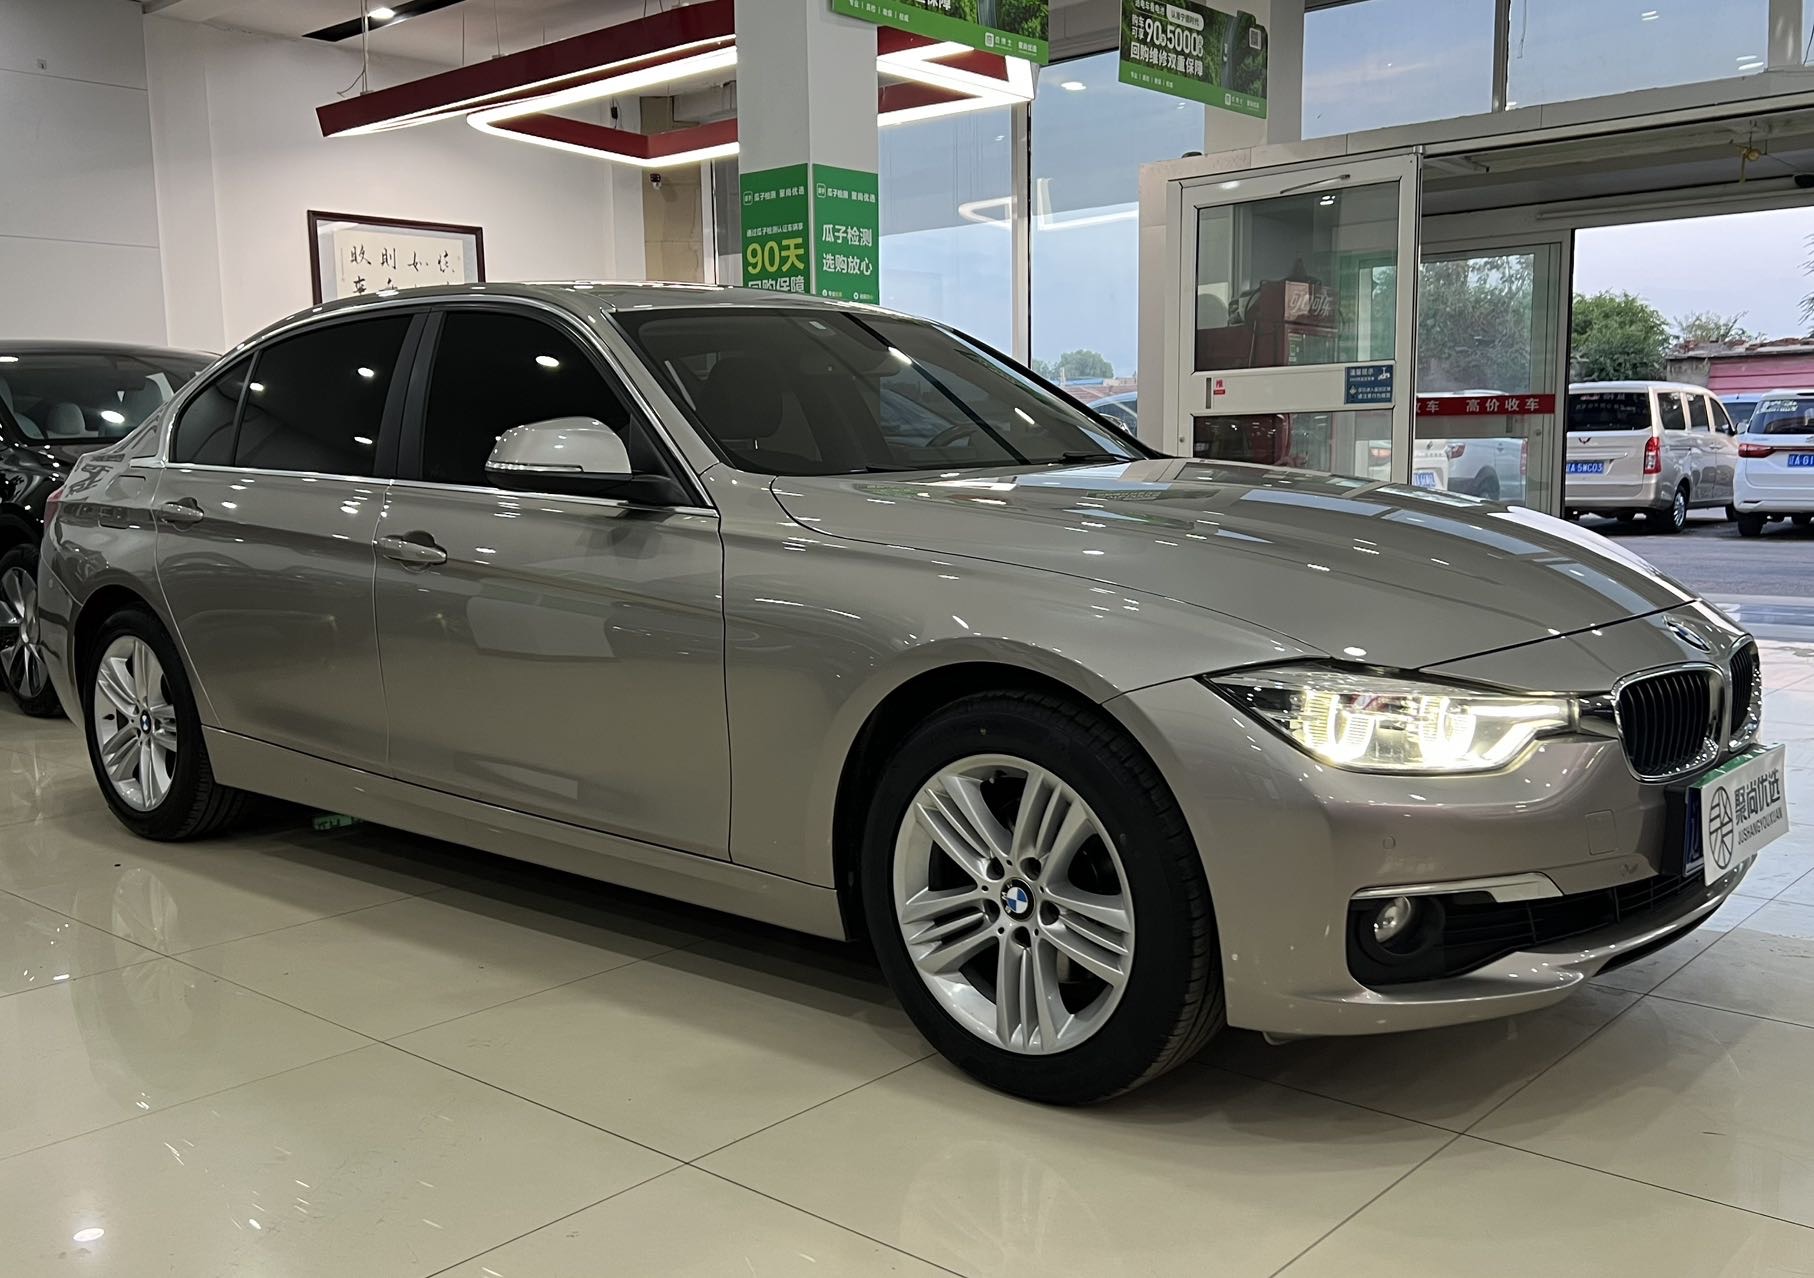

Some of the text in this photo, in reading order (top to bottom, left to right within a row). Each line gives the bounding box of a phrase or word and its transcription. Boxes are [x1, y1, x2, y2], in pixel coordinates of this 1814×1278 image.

[1130, 41, 1203, 77] 回购维修双重保障
[822, 224, 873, 247] 瓜子检测
[746, 237, 805, 275] 90天
[822, 252, 873, 276] 选购放心
[1465, 398, 1540, 413] 高价收车
[1734, 769, 1780, 825] 聚尚优选
